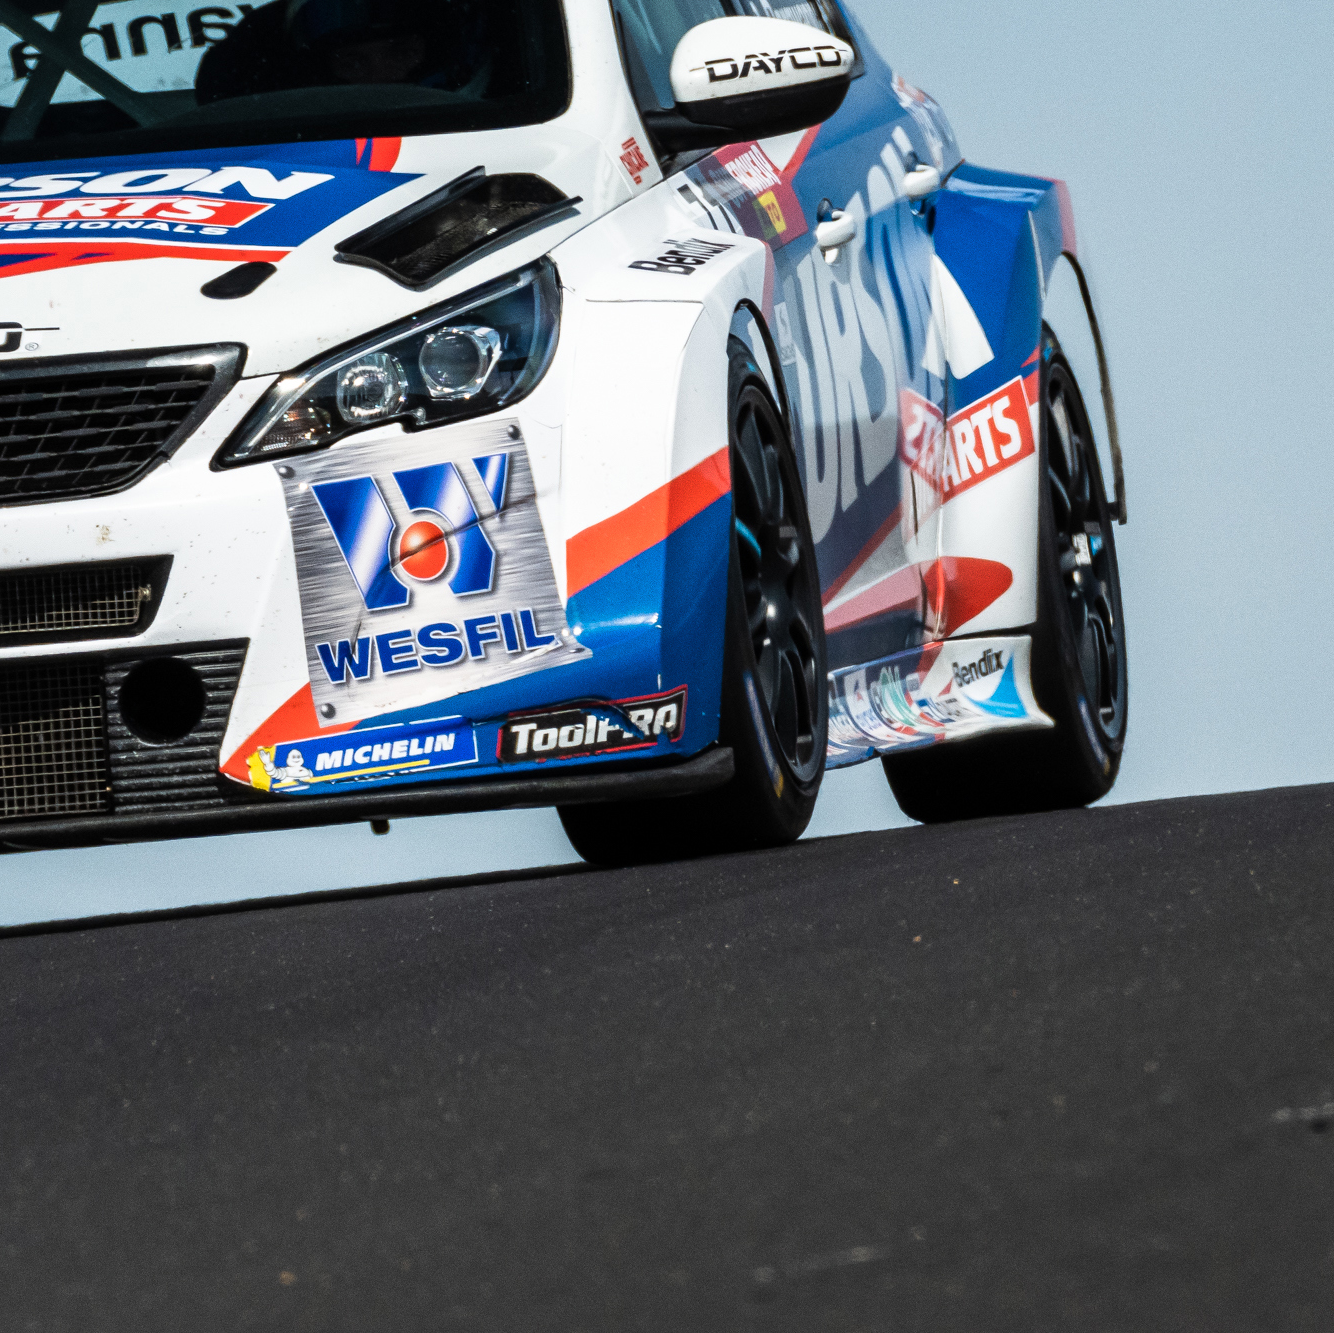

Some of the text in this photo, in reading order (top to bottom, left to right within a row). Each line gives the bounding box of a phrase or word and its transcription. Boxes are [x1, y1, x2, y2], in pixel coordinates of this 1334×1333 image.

[704, 45, 844, 83] DAYCO
[314, 607, 565, 686] WESFIL
[952, 648, 1005, 688] Bendix
[314, 732, 456, 771] MICHELIN
